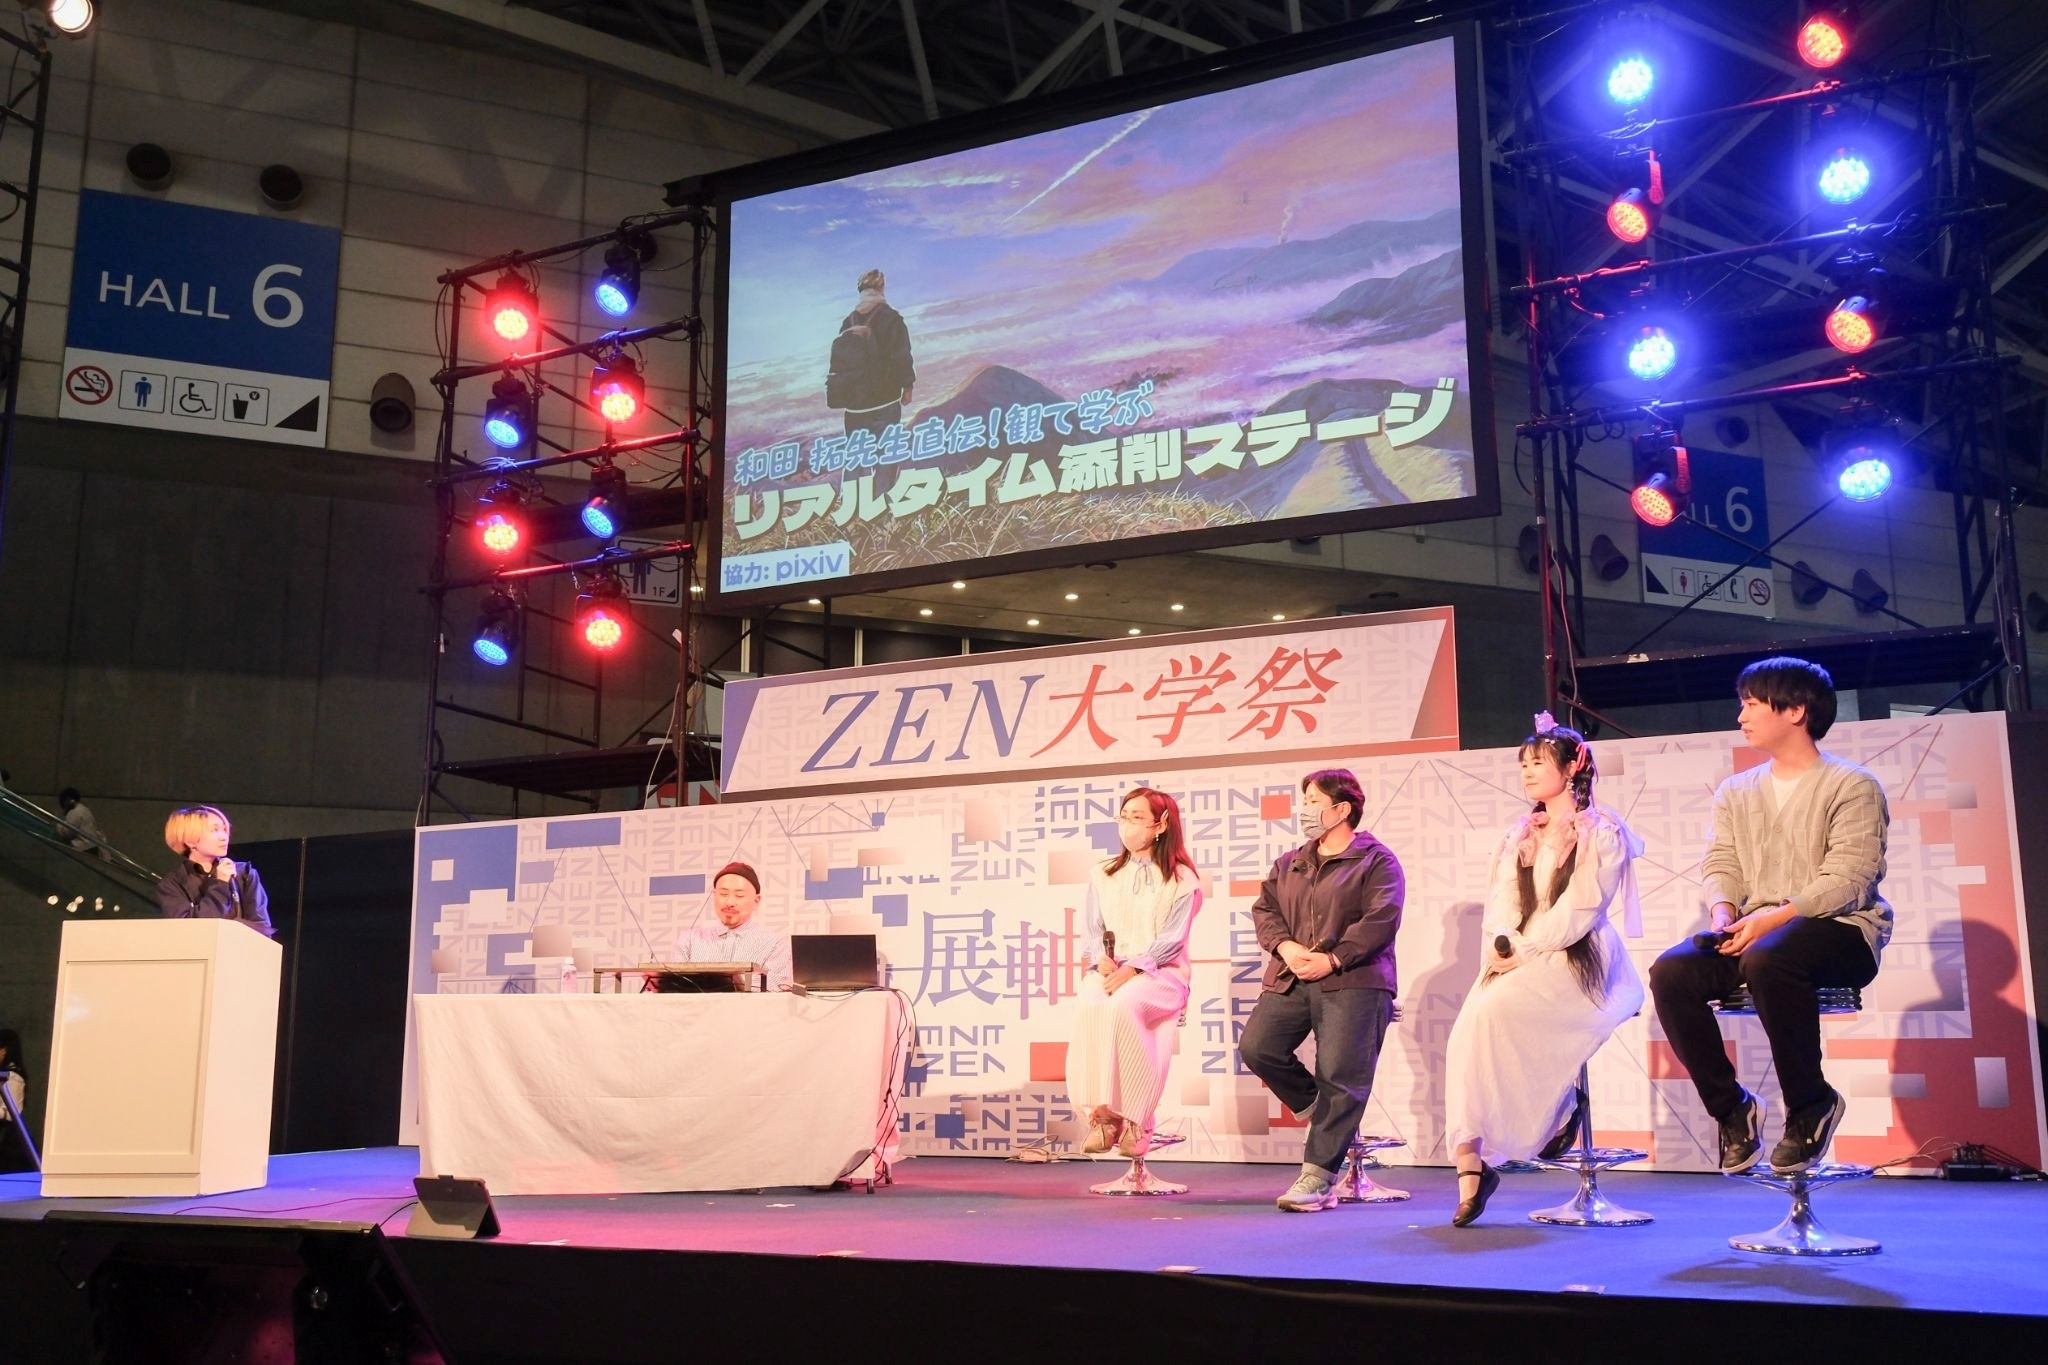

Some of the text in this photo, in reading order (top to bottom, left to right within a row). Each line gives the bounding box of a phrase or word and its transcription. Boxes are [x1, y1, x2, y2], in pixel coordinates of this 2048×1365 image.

[99, 263, 305, 328] HALL 6
[733, 379, 1155, 487] 和田 拓先生直伝!観て学ぶ
[734, 376, 1456, 541] リアルタイム添削ステージ
[1726, 486, 1753, 533] 6
[652, 586, 666, 597] 1F
[724, 549, 845, 588] 協力: pixiv
[800, 646, 1343, 773] ZEN大学祭
